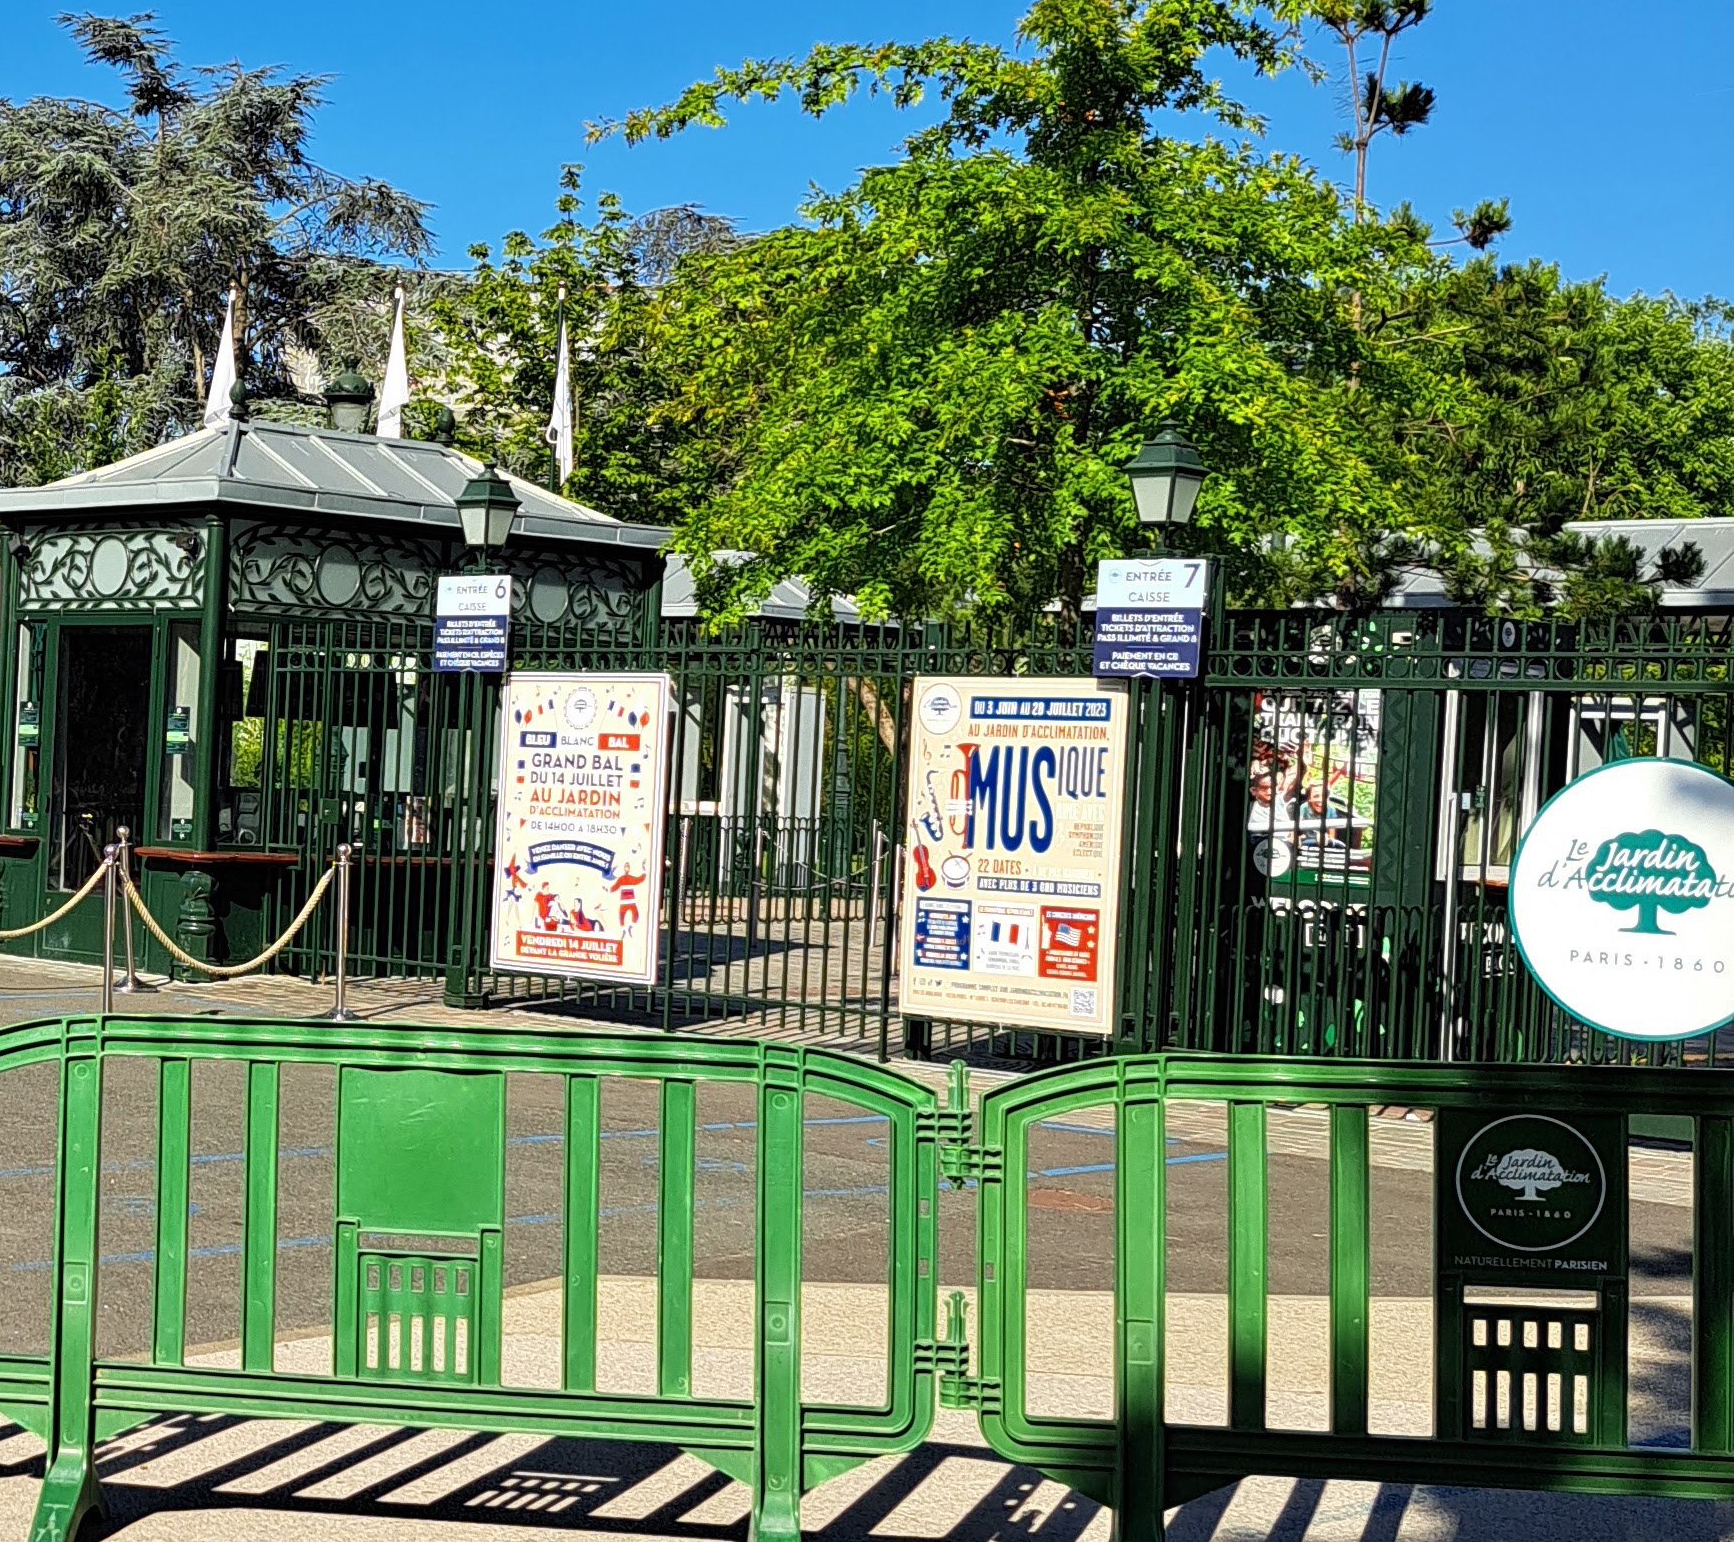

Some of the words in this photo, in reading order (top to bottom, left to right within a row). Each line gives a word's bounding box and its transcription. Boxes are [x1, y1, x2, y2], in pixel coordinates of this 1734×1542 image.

[1126, 569, 1172, 581] ENTRÉE
[1184, 563, 1202, 589] 7
[456, 583, 488, 595] ENTRÉE
[495, 579, 506, 599] 6
[1128, 591, 1170, 603] CAISSE
[1112, 613, 1143, 623] BILLETS
[1144, 611, 1184, 623] D'ENTRÉE
[1101, 623, 1134, 633] TICKETS
[1134, 624, 1194, 633] D'ATTRACTION
[1096, 633, 1116, 642] PASS
[1116, 632, 1152, 643] ILLIMITÉ
[1160, 634, 1190, 643] GRAND
[1112, 651, 1154, 661] PAIEMENT
[1154, 652, 1166, 661] EN
[1166, 653, 1178, 661] CB
[1099, 661, 1110, 670] ET
[1110, 660, 1146, 671] CHÈQUE
[1146, 662, 1191, 671] VACANCES
[974, 701, 986, 715] DU
[986, 701, 994, 715] 3
[996, 701, 1018, 715] JUIN
[1019, 702, 1030, 715] AU
[1032, 702, 1044, 716] 28
[1046, 702, 1084, 717] JUILLET
[1085, 703, 1107, 717] 2023
[968, 723, 980, 737] AU
[983, 724, 1018, 738] JARDIN
[525, 733, 551, 746] BLEU
[560, 735, 595, 747] BLANC
[608, 736, 630, 749] BAL
[532, 753, 588, 769] GRAND
[592, 755, 624, 771] BAL
[530, 771, 548, 785] DU
[551, 772, 565, 785] 14
[568, 773, 623, 788] JUILLET
[530, 787, 552, 803] AU
[558, 789, 622, 807] JARDIN
[967, 745, 1108, 853] MUSIQUE
[530, 805, 620, 819] D'ACCLIMATATION
[530, 821, 542, 831] DE
[545, 821, 575, 831] 14H00
[586, 824, 617, 835] 18H30
[1566, 839, 1590, 861] Le
[1596, 839, 1700, 871] Jardin
[978, 859, 990, 873] 22
[992, 859, 1022, 875] DATES
[979, 877, 998, 889] AVEC
[998, 879, 1019, 891] PLUS
[1020, 881, 1030, 891] DE
[1032, 881, 1038, 892] 3
[1056, 883, 1100, 896] MUSICIENS
[520, 934, 566, 948] VENDREDI
[568, 939, 578, 949] 14
[580, 940, 618, 953] JUILLET
[1570, 950, 1632, 967] PARIS
[1658, 956, 1725, 973] 1860
[1486, 1153, 1498, 1166] Le
[1502, 1154, 1556, 1170] Jardin
[1470, 1164, 1591, 1183] d'Acclimatation
[1490, 1209, 1525, 1217] PARIS
[1454, 1255, 1554, 1269] NATURELLEMENT
[1554, 1261, 1608, 1271] PARISIEN
